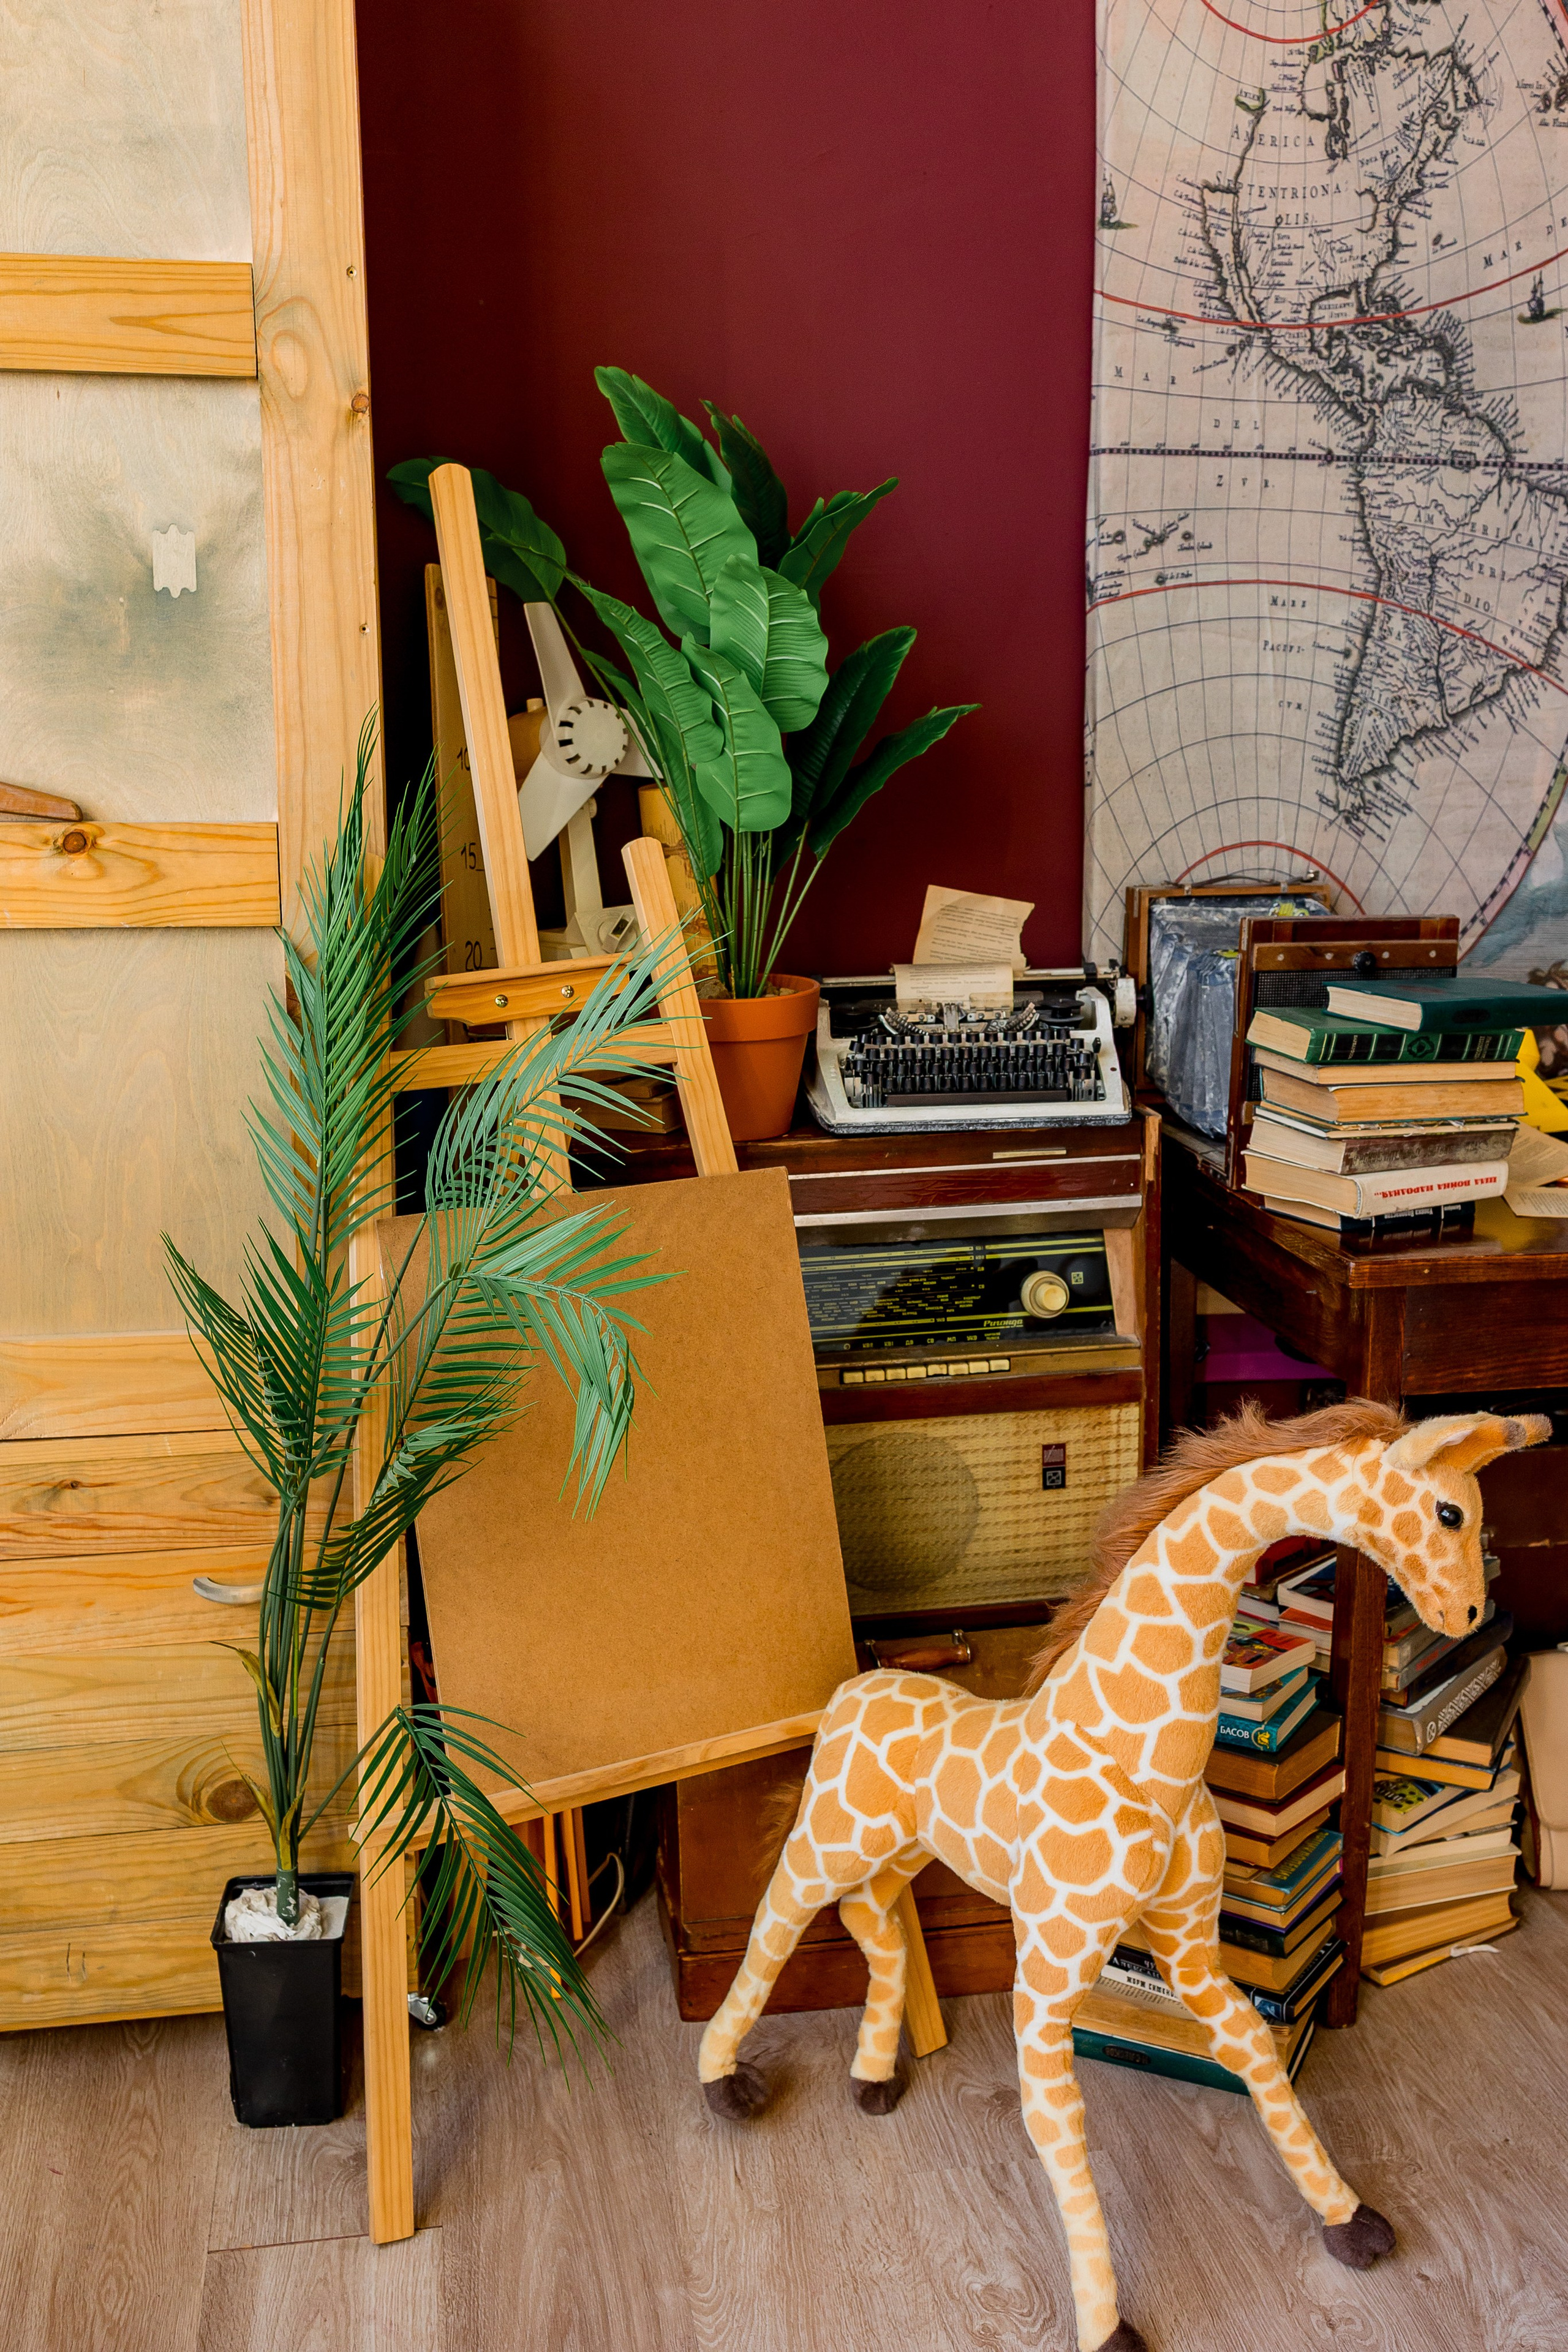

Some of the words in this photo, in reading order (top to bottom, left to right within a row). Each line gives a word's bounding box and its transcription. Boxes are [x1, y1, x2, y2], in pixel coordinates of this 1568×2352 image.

[1231, 124, 1315, 147] AMERICA
[1483, 241, 1523, 269] MAR
[1114, 366, 1176, 385] MAR
[1213, 418, 1259, 429] DEL
[1270, 595, 1306, 608] MARE
[1464, 592, 1491, 612] DIO
[457, 745, 471, 771] 10
[461, 842, 477, 870] 15
[465, 940, 483, 971] 20
[1438, 1178, 1471, 1191] ВОЙНА
[1474, 1176, 1497, 1186] ШЛА
[1374, 1185, 1434, 1199] НАРОДНАЯ...
[1220, 1725, 1250, 1739] БАСОВ
[1126, 1975, 1147, 1988] ЖОРЖ
